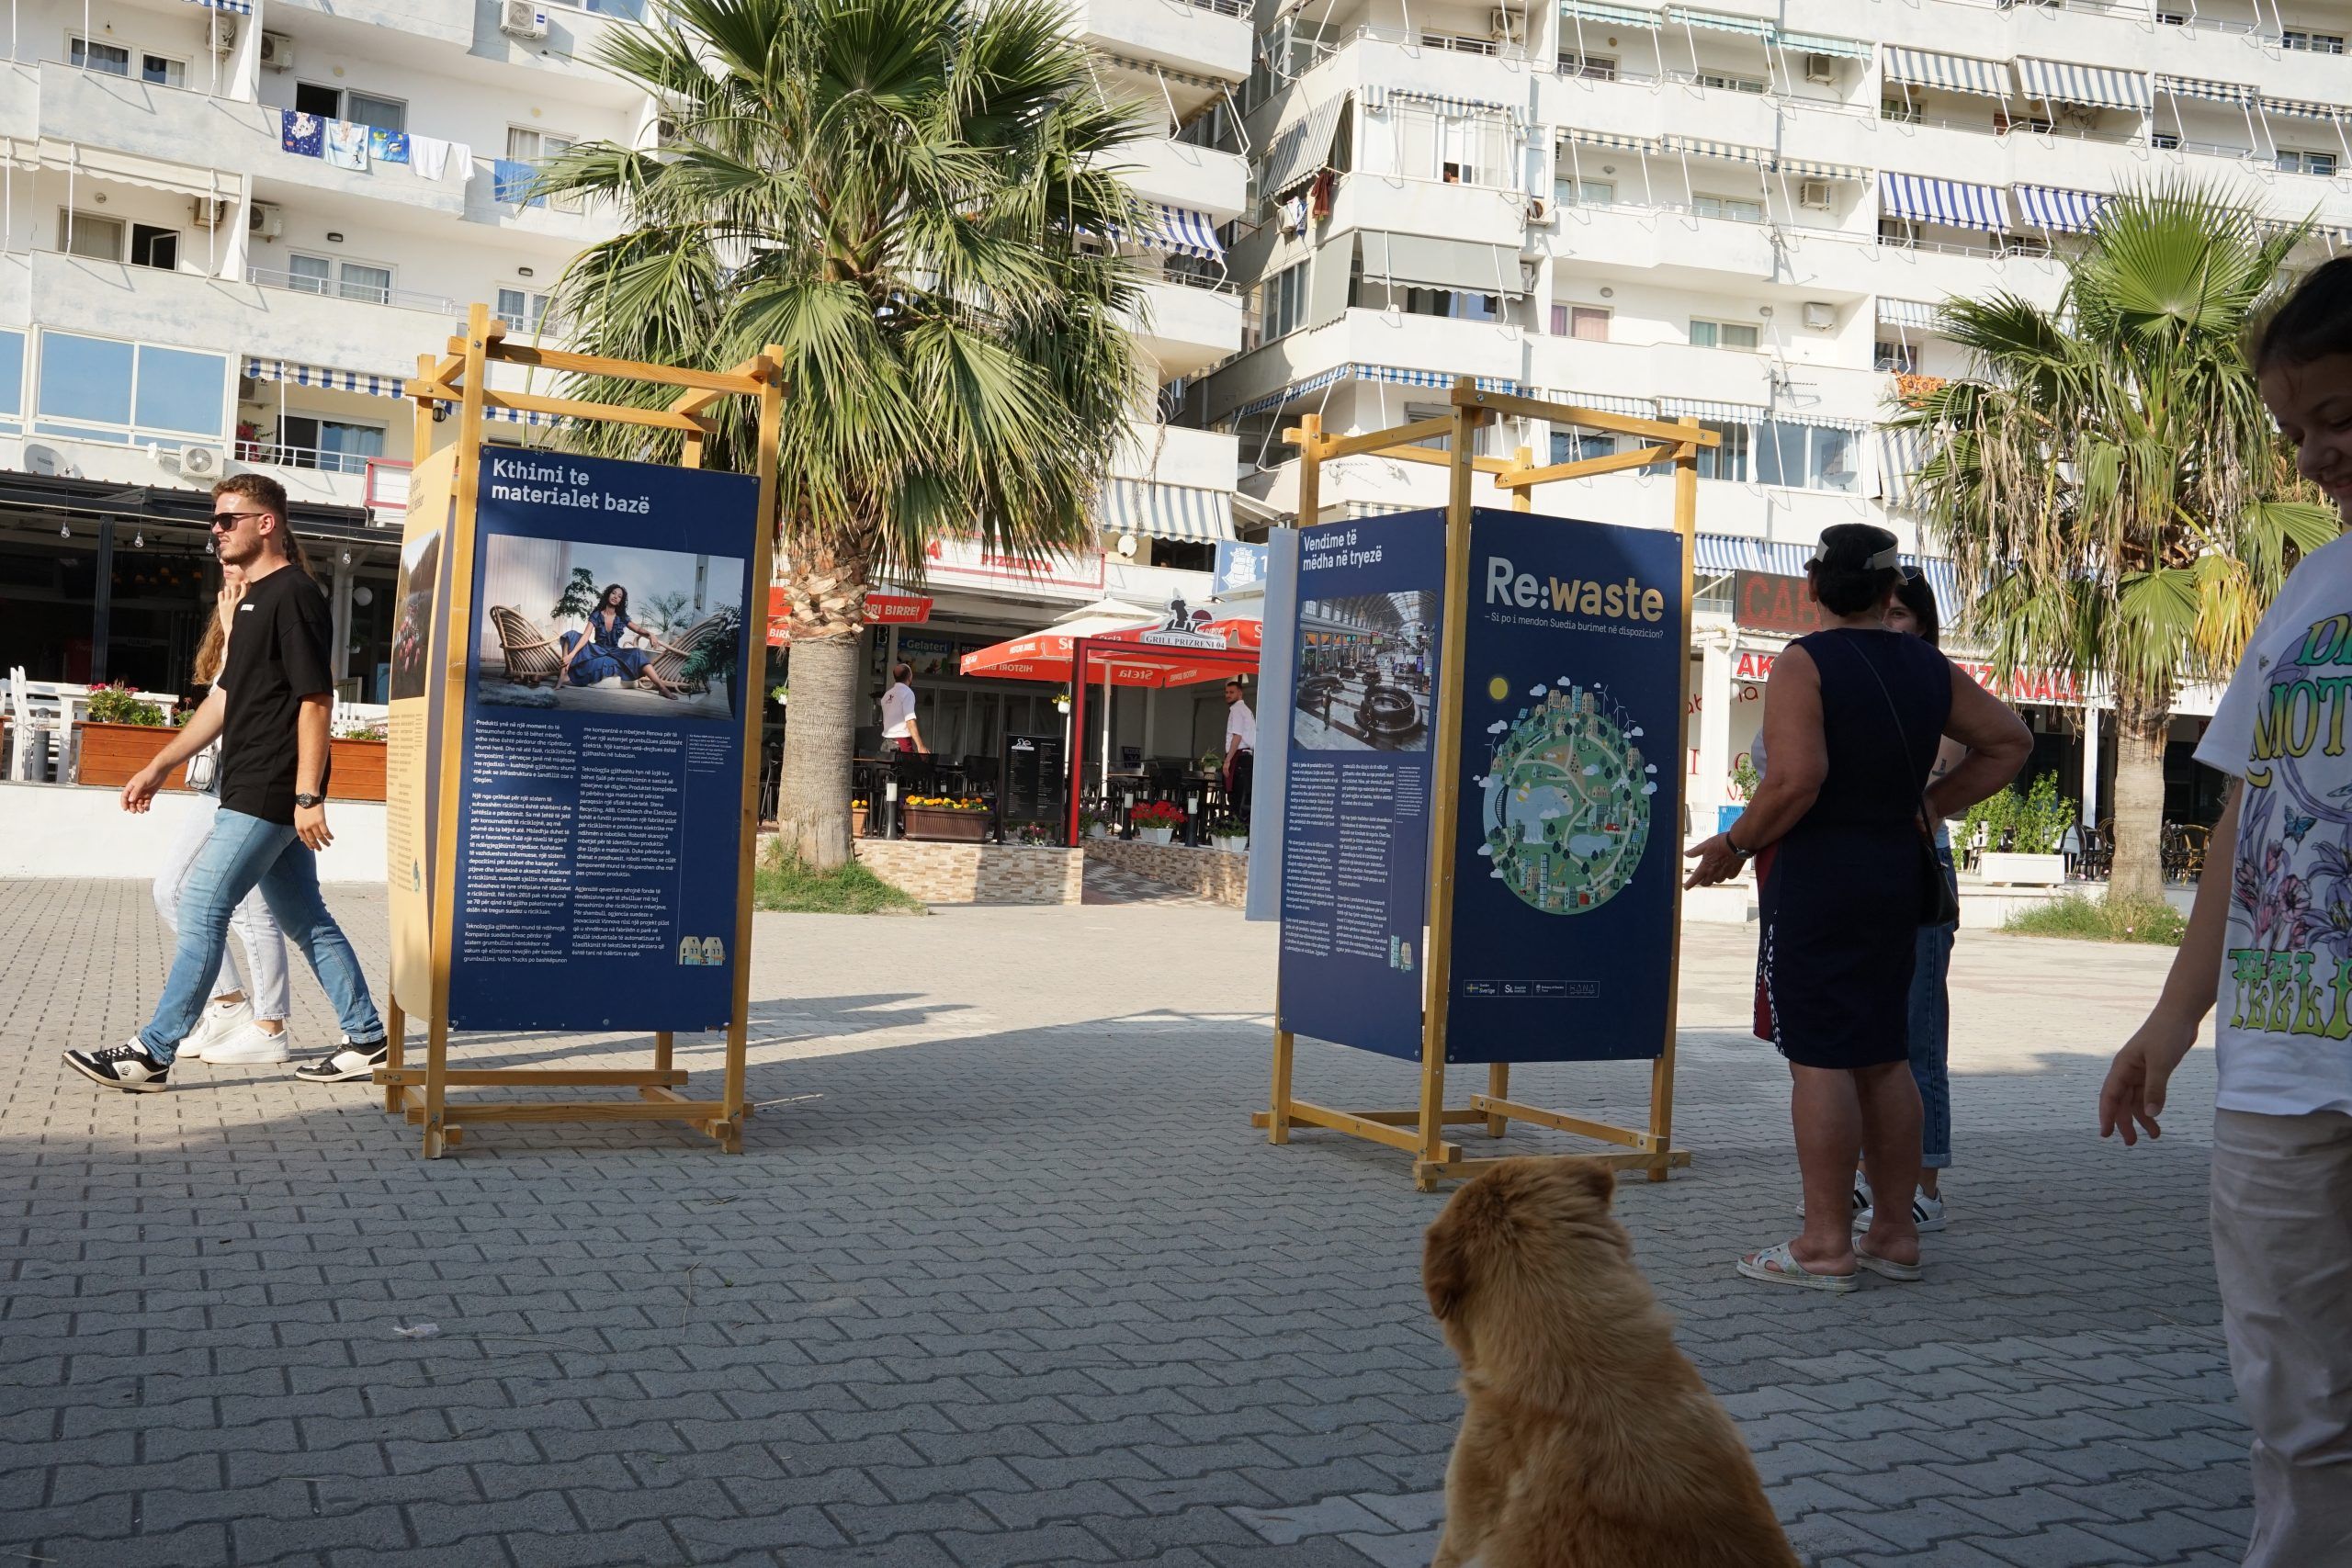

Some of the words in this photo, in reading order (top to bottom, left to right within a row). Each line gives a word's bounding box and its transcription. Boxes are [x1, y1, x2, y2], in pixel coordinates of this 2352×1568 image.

[492, 458, 563, 485] Kthimi
[569, 467, 590, 486] te
[492, 484, 599, 510] materialet
[605, 495, 650, 514] bazë
[1304, 535, 1344, 552] Vendime
[1347, 529, 1357, 546] të
[1303, 552, 1334, 571] mëdha
[1336, 549, 1348, 567] në
[1350, 545, 1383, 569] tryezë
[1486, 556, 1664, 623] Re:waste
[885, 604, 921, 615] BIRRE!
[1490, 613, 1499, 622] Si
[1500, 615, 1511, 625] po
[1518, 616, 1549, 626] mendon
[1550, 618, 1577, 629] Suedia
[1577, 622, 1607, 633] burimet
[1608, 625, 1617, 634] në
[1618, 626, 1664, 638] dispozicion?
[906, 639, 947, 651] Gelateri
[1146, 636, 1172, 645] GRILL
[1174, 637, 1215, 649] PRIZRENI
